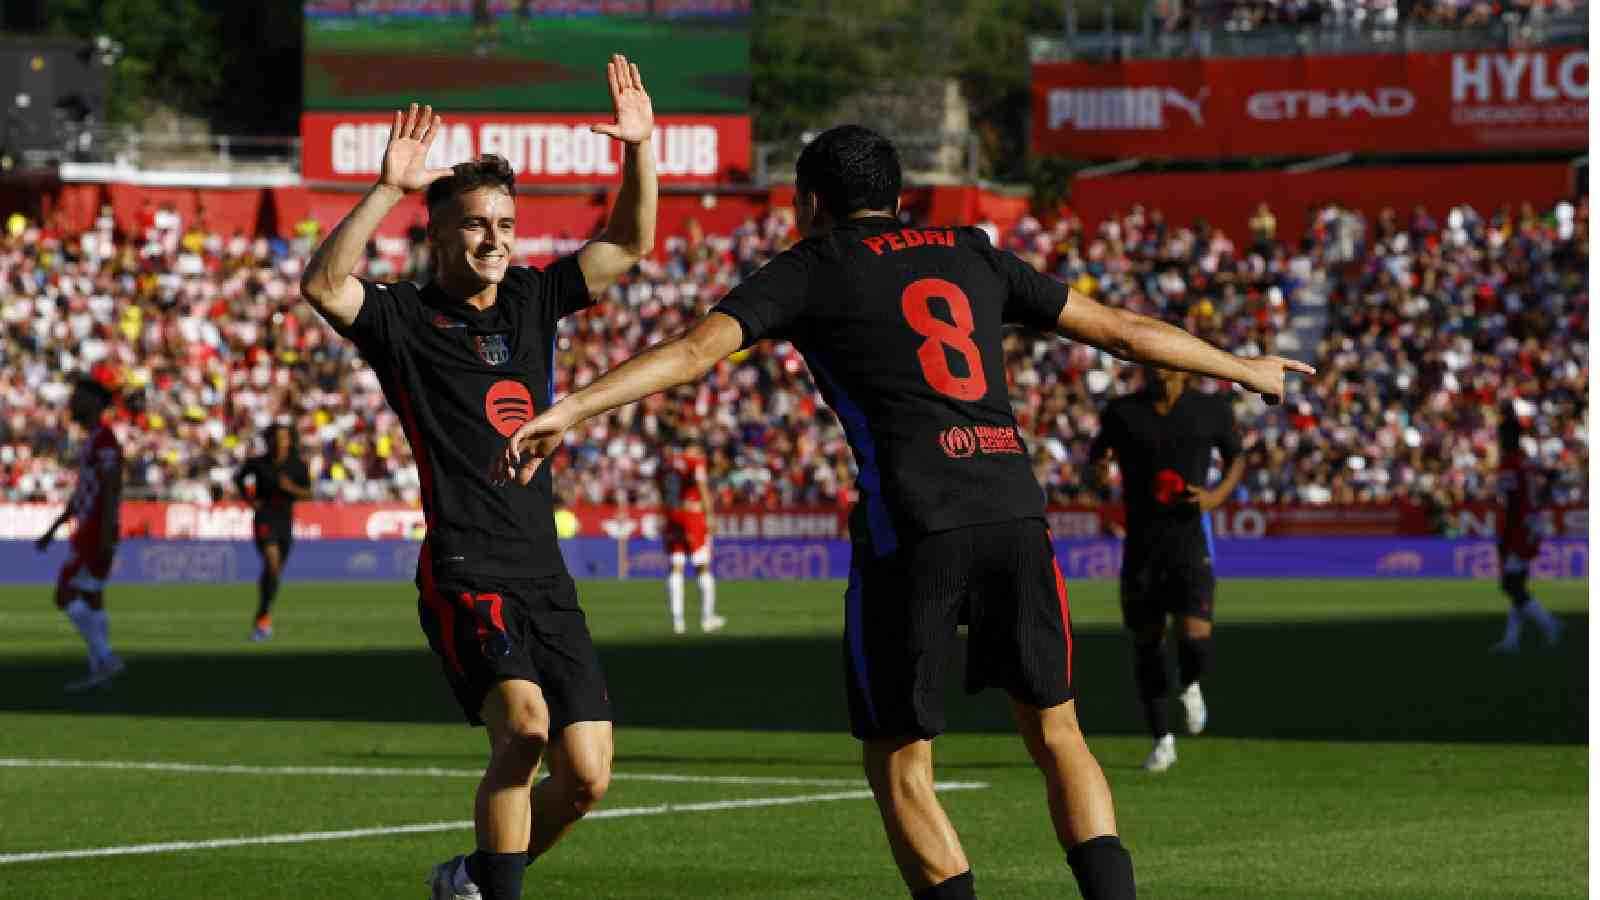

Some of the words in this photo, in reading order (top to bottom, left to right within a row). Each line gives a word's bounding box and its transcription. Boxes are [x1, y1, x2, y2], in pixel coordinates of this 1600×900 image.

[1048, 88, 1163, 129] PUMA
[1246, 88, 1416, 122] ETIHAD
[332, 122, 472, 175] GIRNA
[621, 125, 718, 176] LUB
[861, 228, 955, 255] PEDRI
[901, 278, 989, 401] 8
